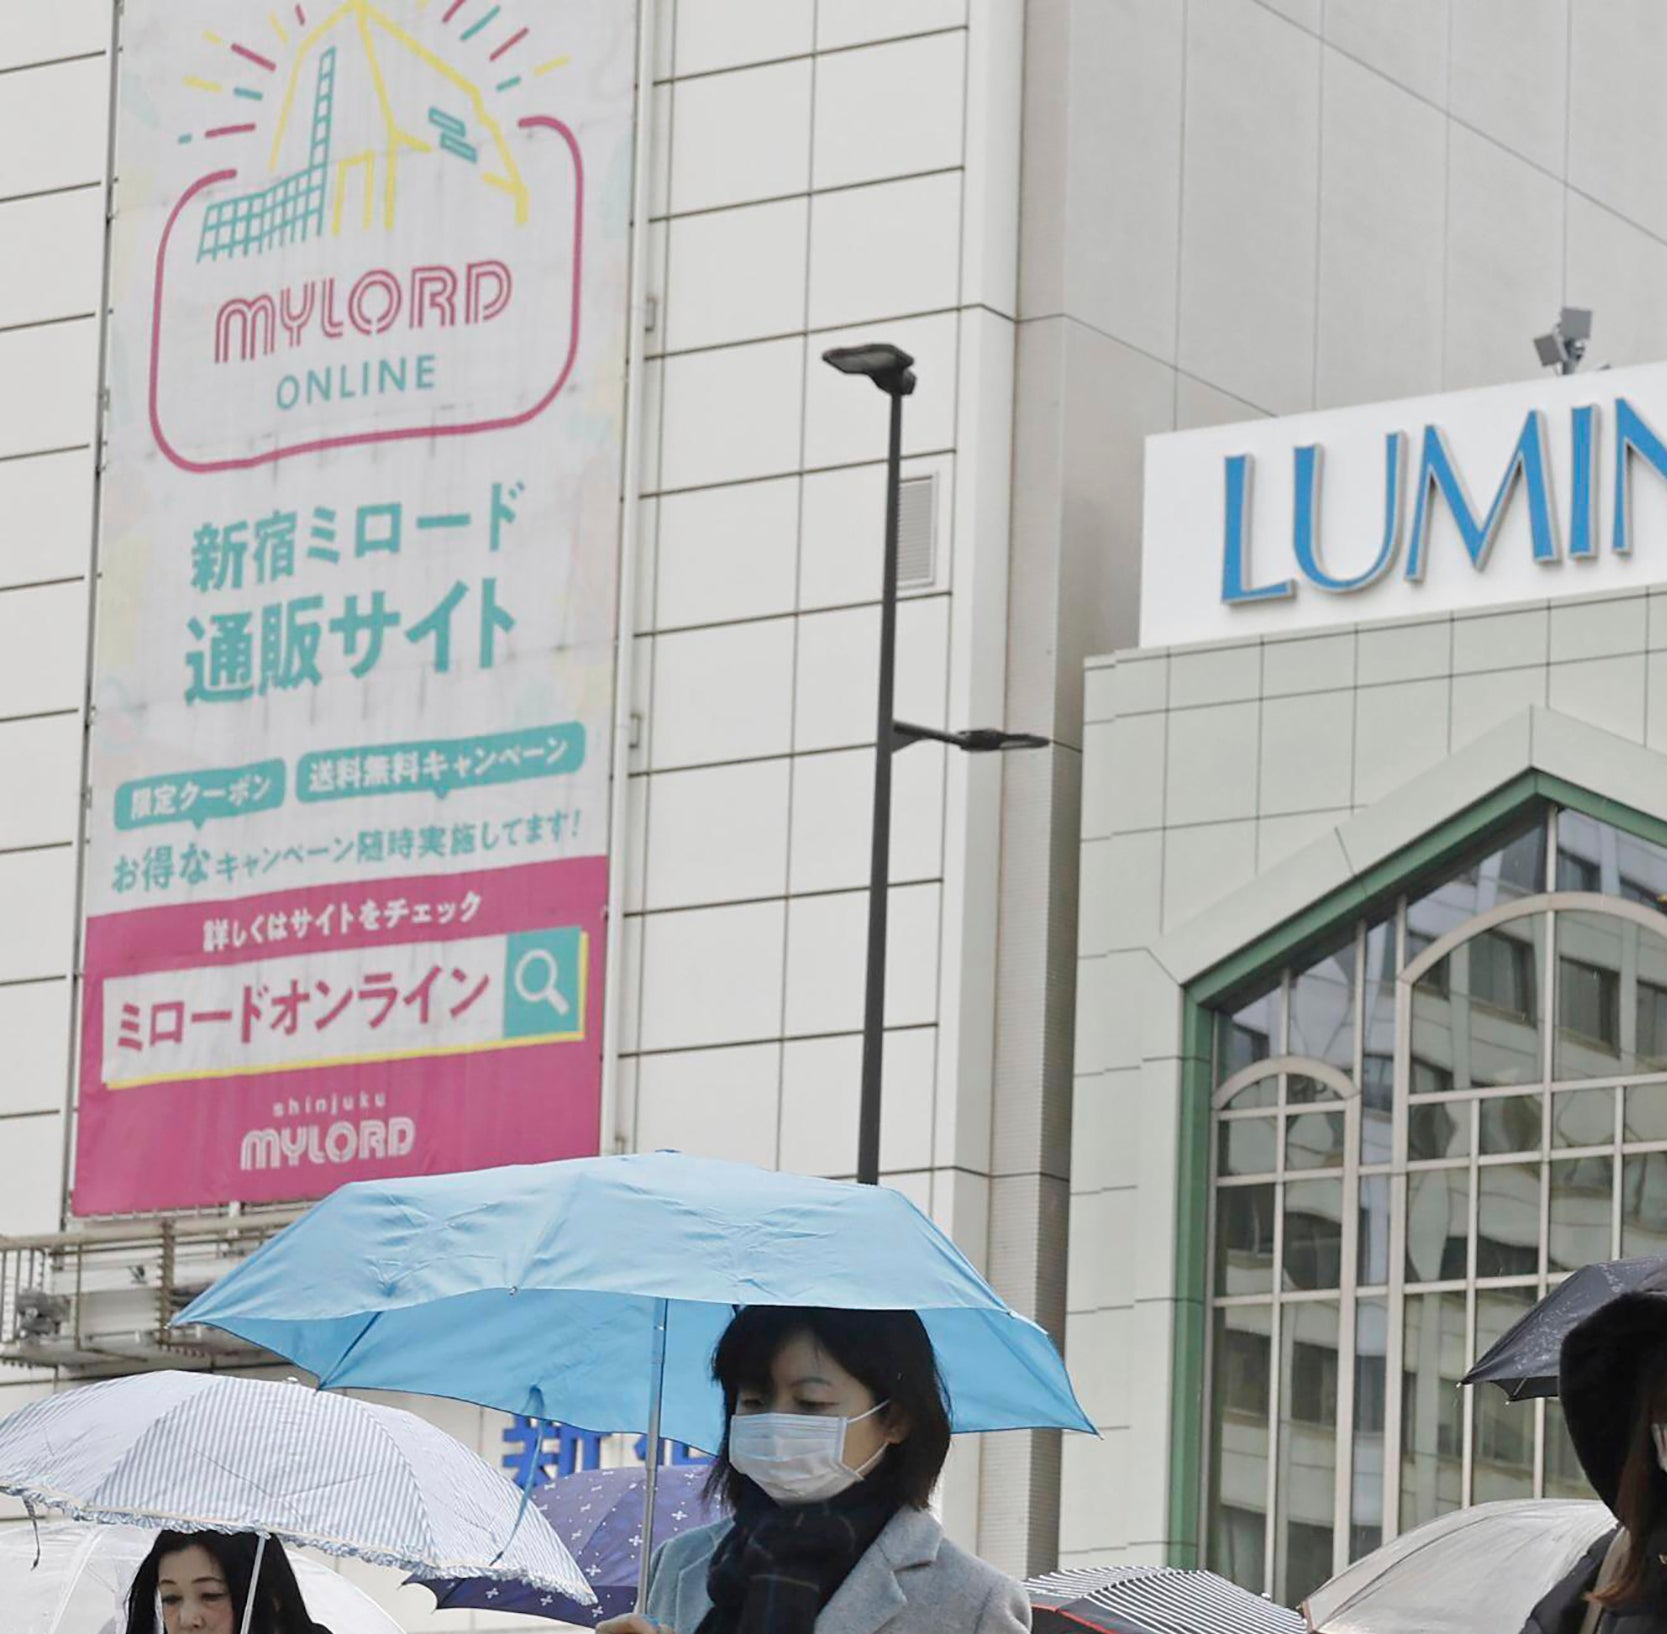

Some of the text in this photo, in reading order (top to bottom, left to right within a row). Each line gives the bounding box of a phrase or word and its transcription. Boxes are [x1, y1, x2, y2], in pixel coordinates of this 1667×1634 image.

[214, 259, 512, 364] MYLORD
[276, 354, 436, 410] ONLINE
[191, 481, 526, 595] 新宿ミロード
[184, 577, 518, 704] 通販サイト
[308, 736, 568, 793] 送料無料キャンペーン
[130, 773, 272, 821] 限定クーポン
[202, 890, 482, 952] 詳しくはサイトをチェック
[116, 963, 492, 1053] ミロードオンライン
[273, 1090, 386, 1117] shinjuku
[240, 1116, 416, 1171] MYLORD
